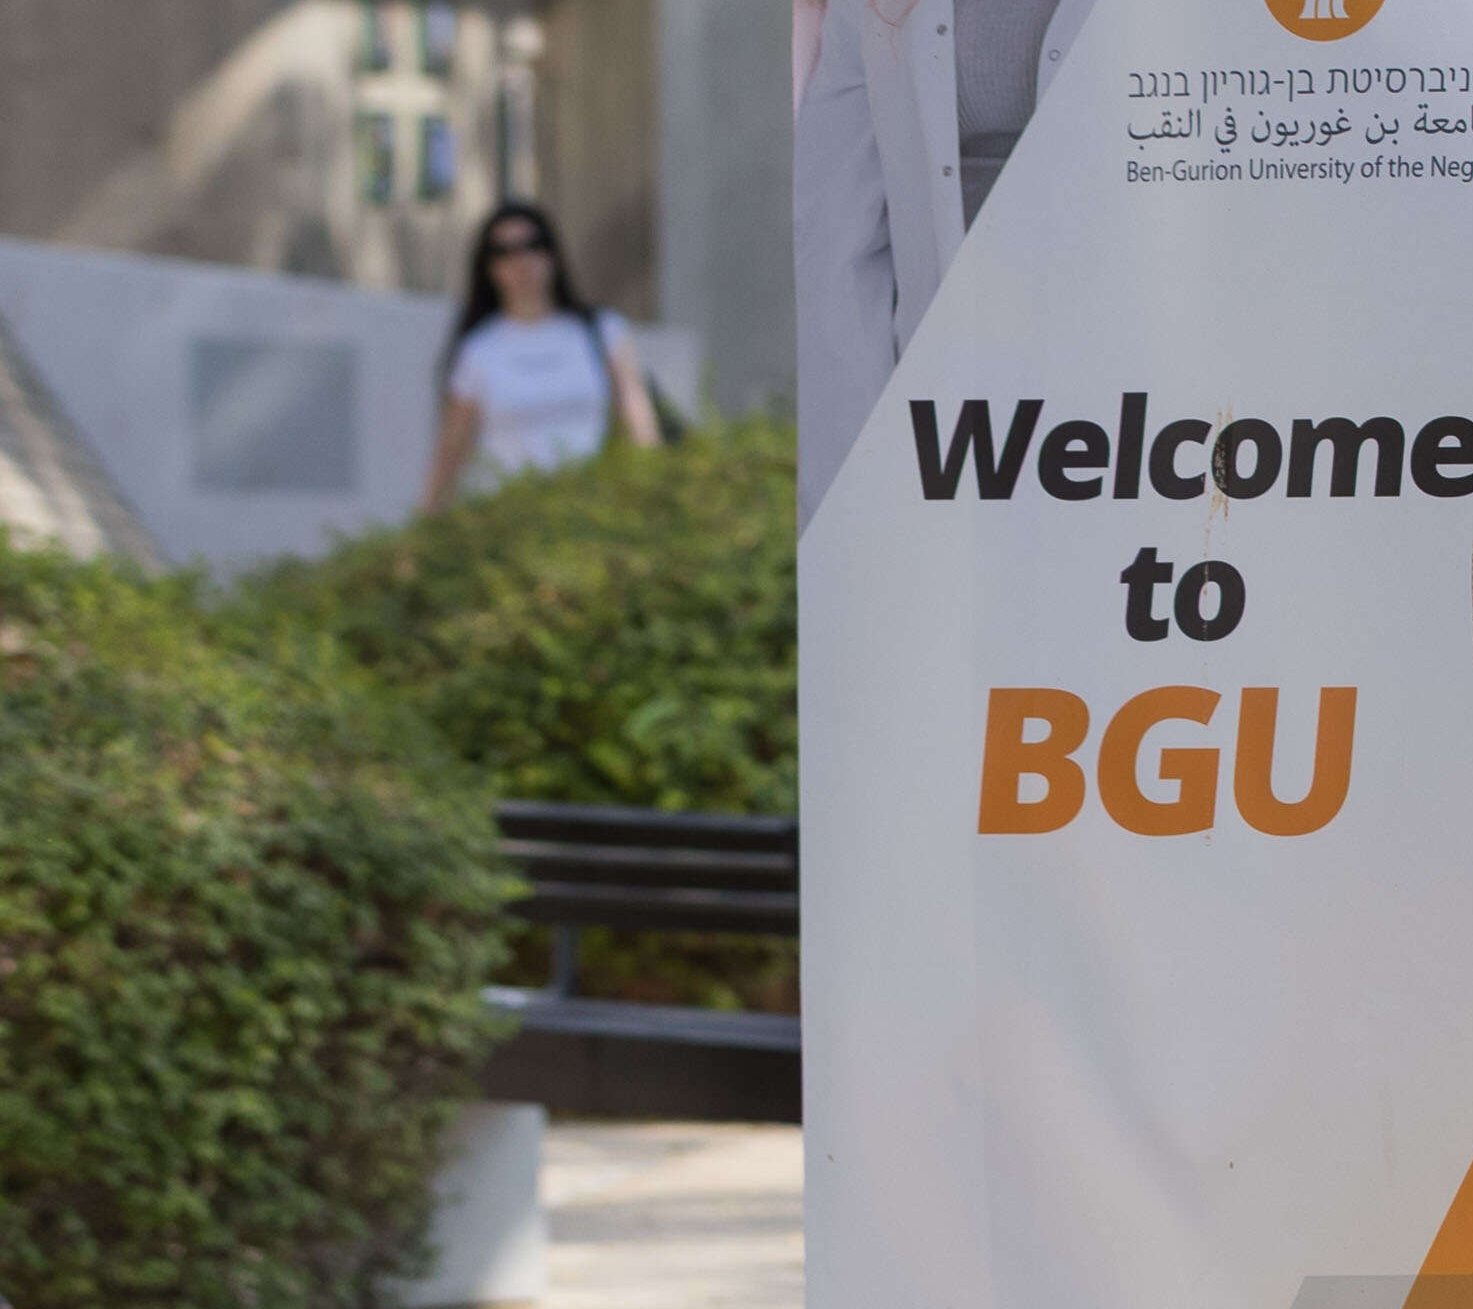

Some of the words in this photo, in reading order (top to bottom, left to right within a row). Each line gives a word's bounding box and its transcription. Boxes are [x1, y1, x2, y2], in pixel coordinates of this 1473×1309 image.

[1128, 71, 1191, 98] בנגב
[1200, 68, 1316, 105] בן-גוריון
[1127, 107, 1201, 151] النقب
[1214, 105, 1238, 153] في
[1251, 105, 1353, 147] غوريون
[1364, 112, 1400, 146] بن
[1127, 159, 1242, 183] Ben-Gurion
[1249, 156, 1355, 185] University
[1360, 154, 1385, 179] of
[1387, 155, 1424, 178] the
[1119, 546, 1246, 643] to
[977, 685, 1358, 837] BGU
